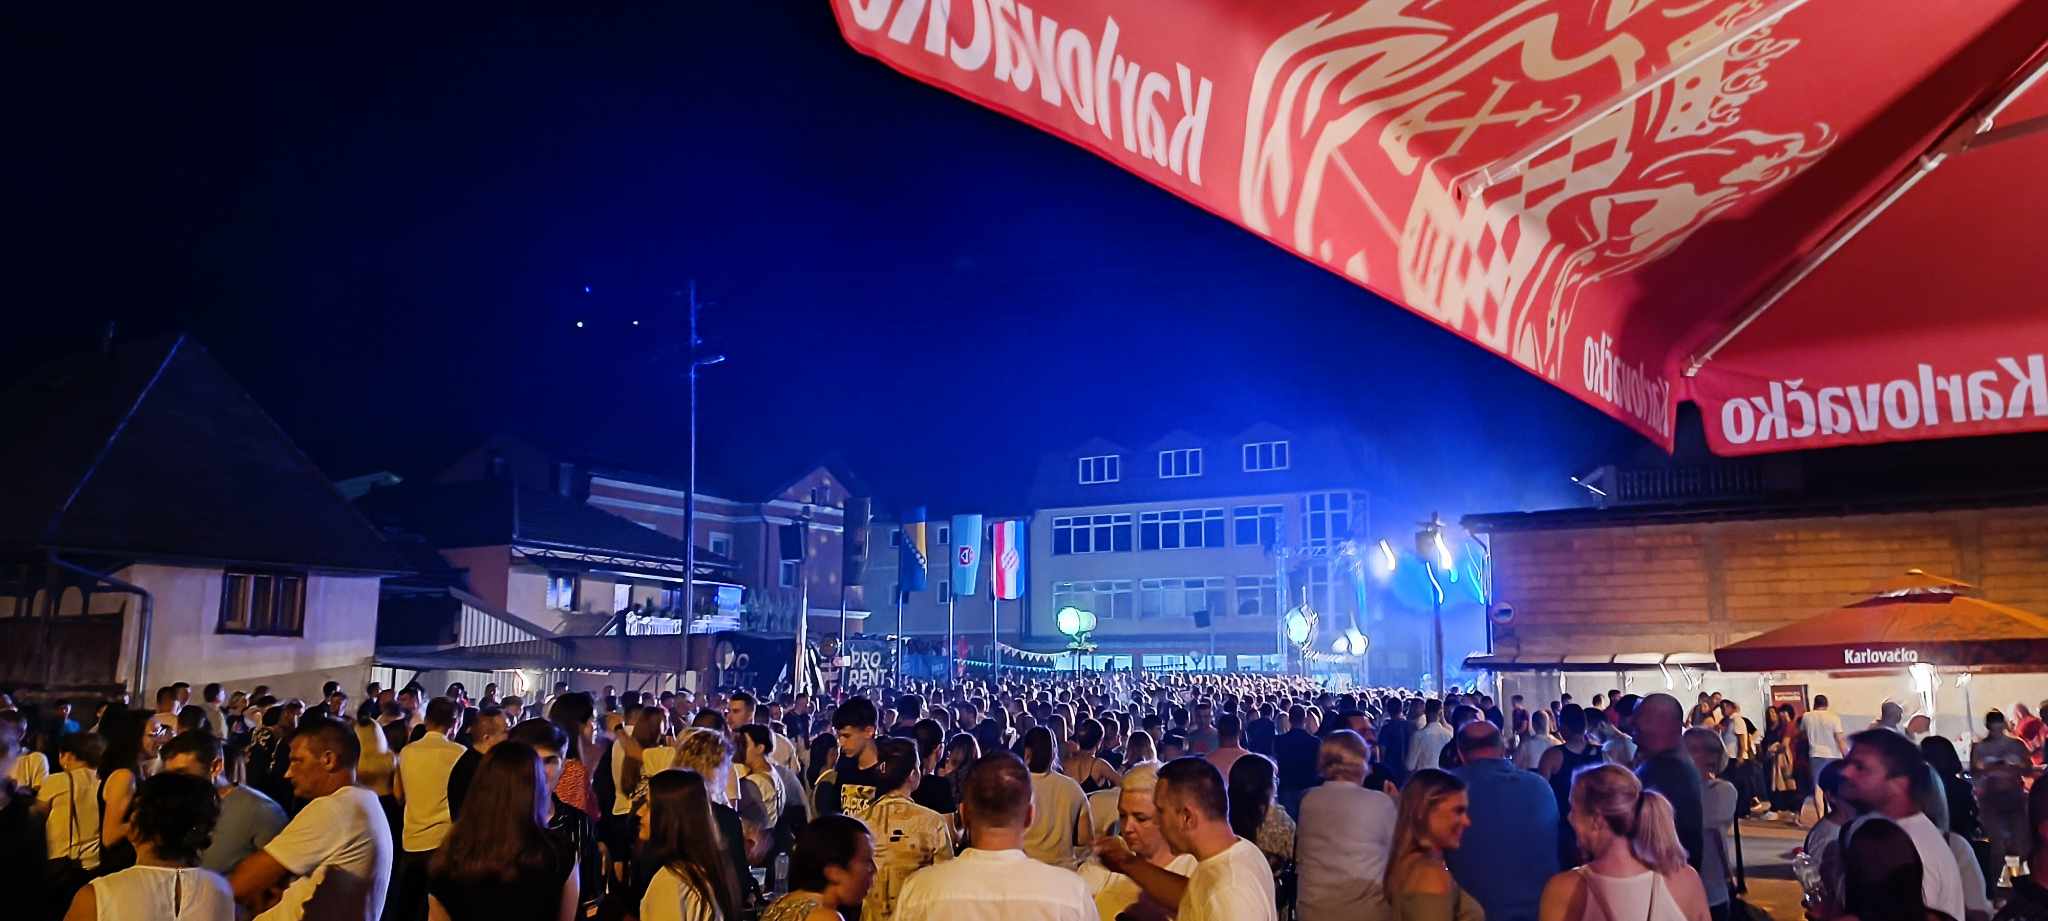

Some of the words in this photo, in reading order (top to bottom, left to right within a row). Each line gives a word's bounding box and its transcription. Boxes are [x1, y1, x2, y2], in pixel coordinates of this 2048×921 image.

[851, 651, 881, 668] PRO
[1844, 648, 1918, 664] Karlovačko
[849, 669, 888, 685] RENT
